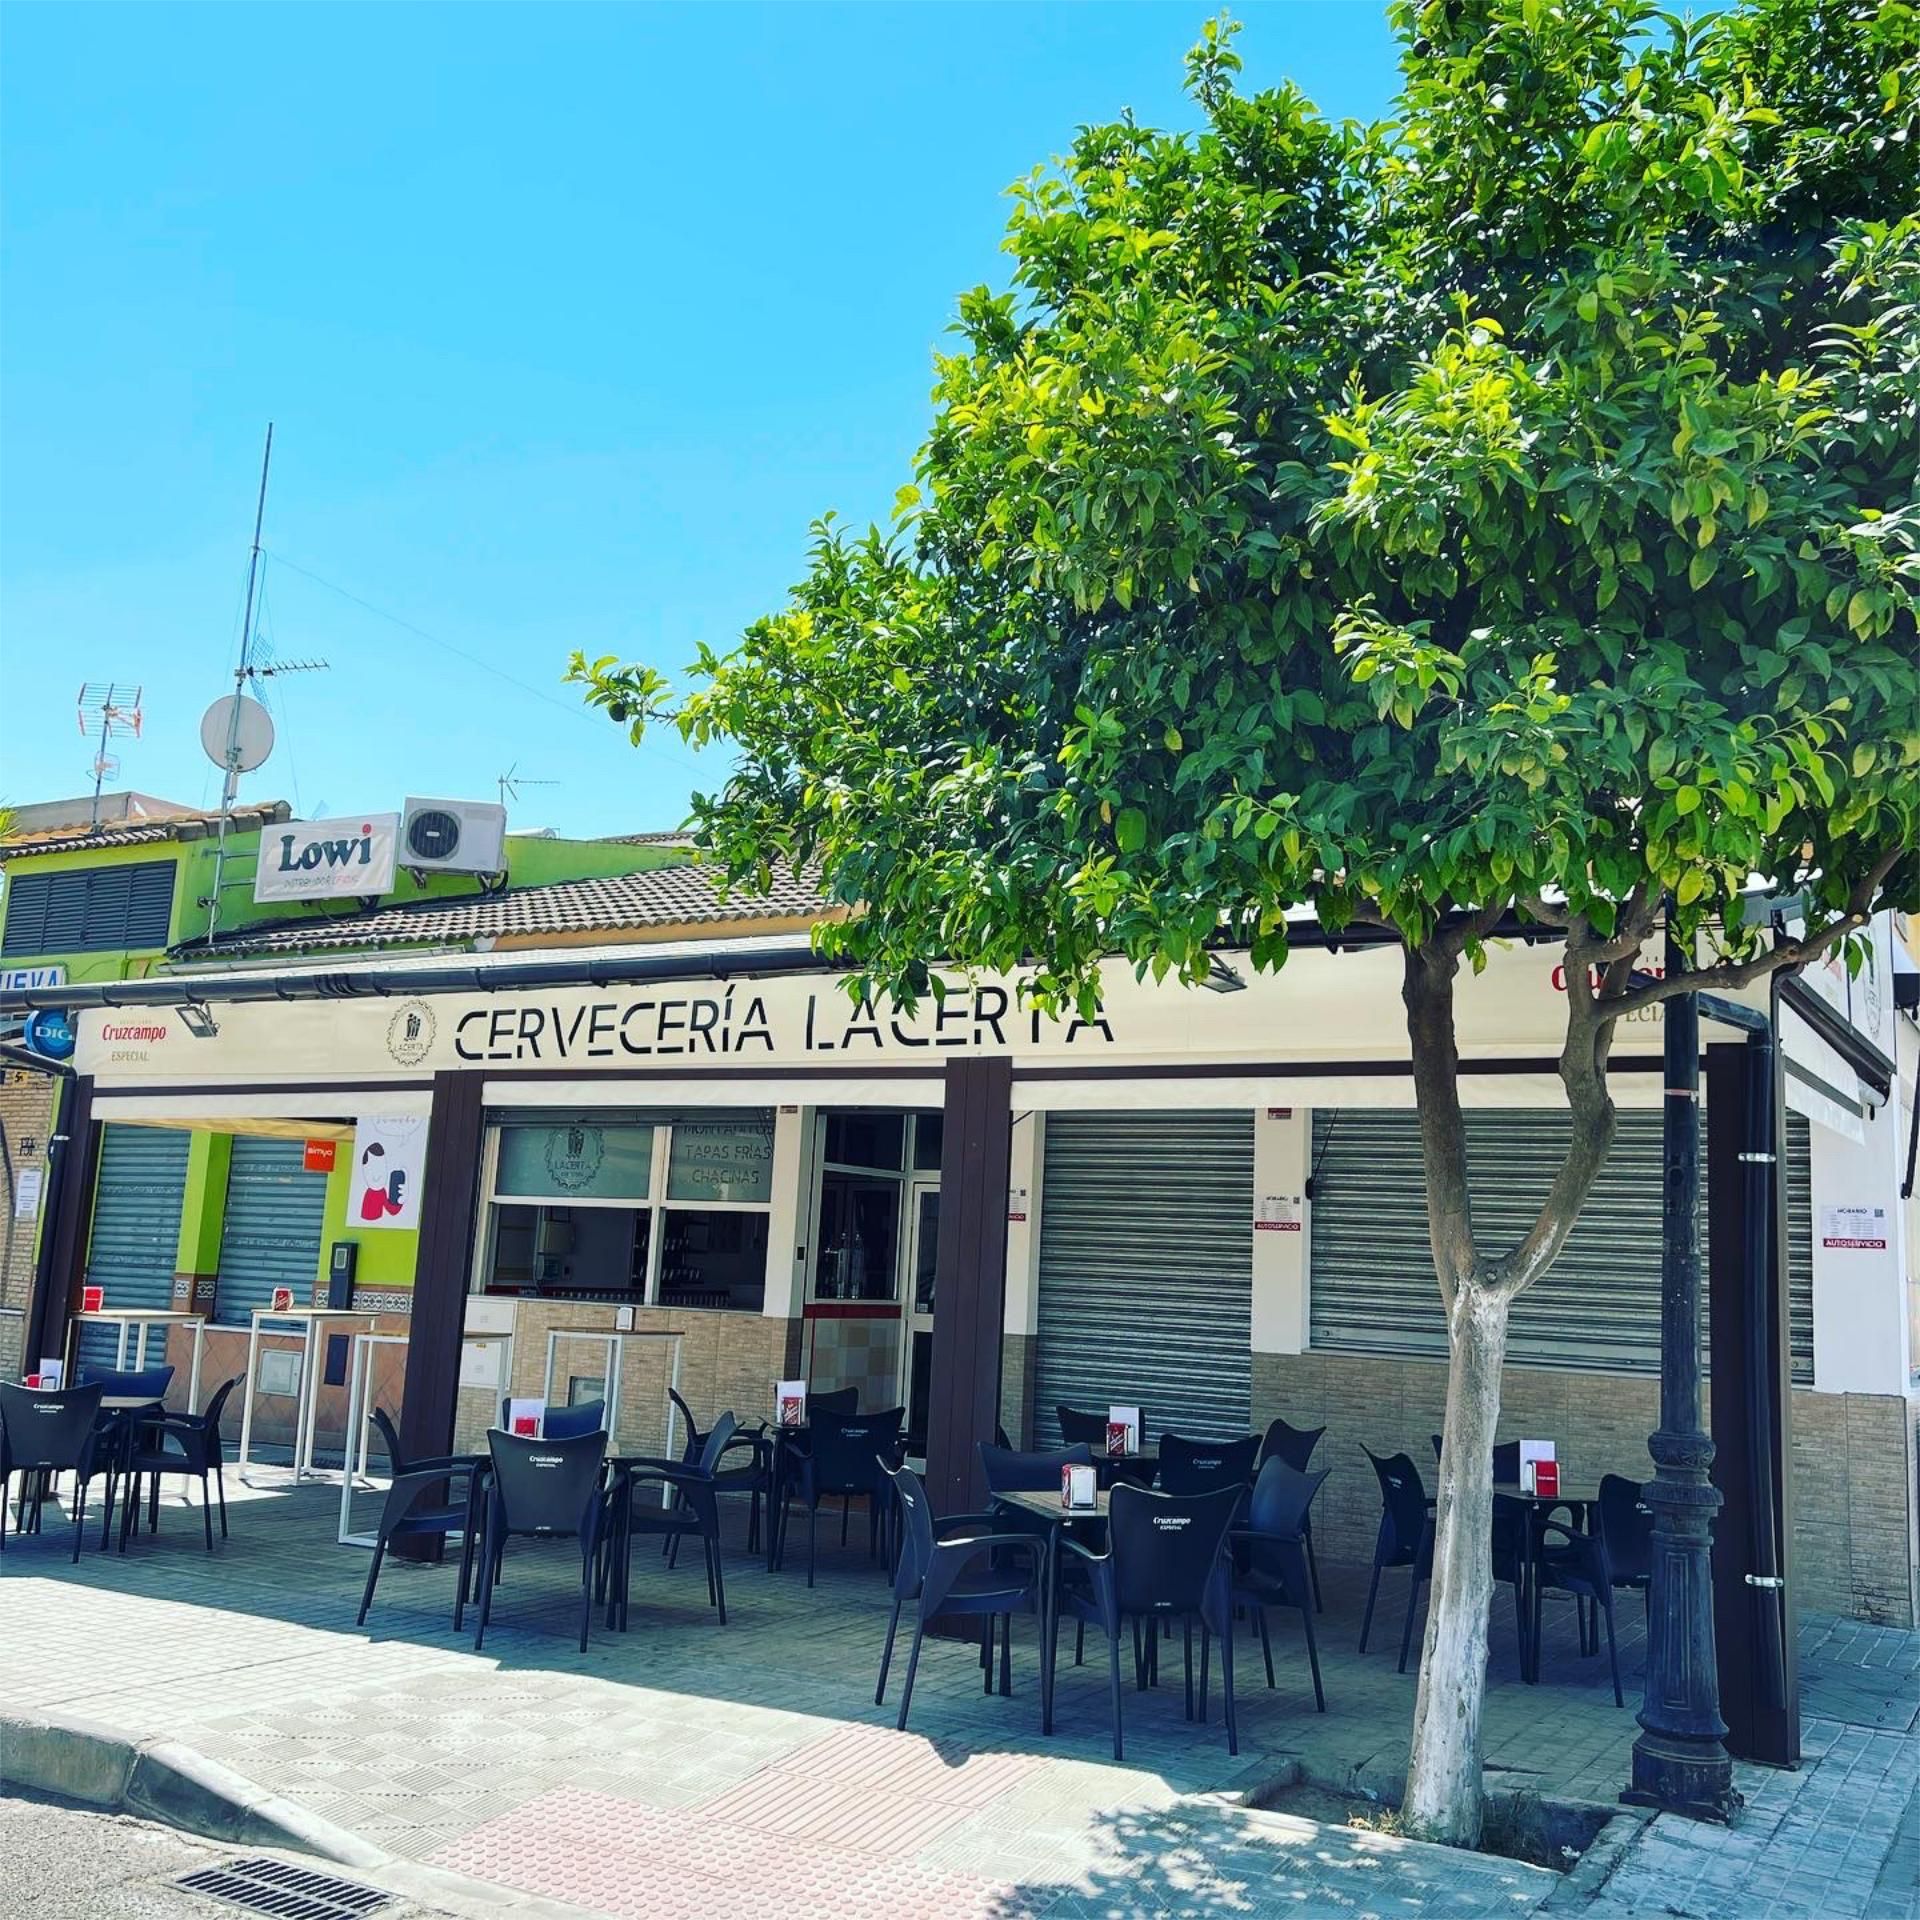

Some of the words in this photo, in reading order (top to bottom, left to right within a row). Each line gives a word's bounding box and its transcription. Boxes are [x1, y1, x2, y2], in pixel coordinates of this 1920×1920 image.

[278, 823, 372, 872] Lowi
[455, 984, 775, 1061] CERVECERÍA
[805, 985, 1115, 1050] LACERTA
[35, 1026, 74, 1041] DIG
[102, 1024, 167, 1042] Cruzcampo
[111, 1050, 150, 1063] ESPECIAL
[685, 1144, 729, 1161] TAPAS
[691, 1168, 761, 1185] CHACINAS
